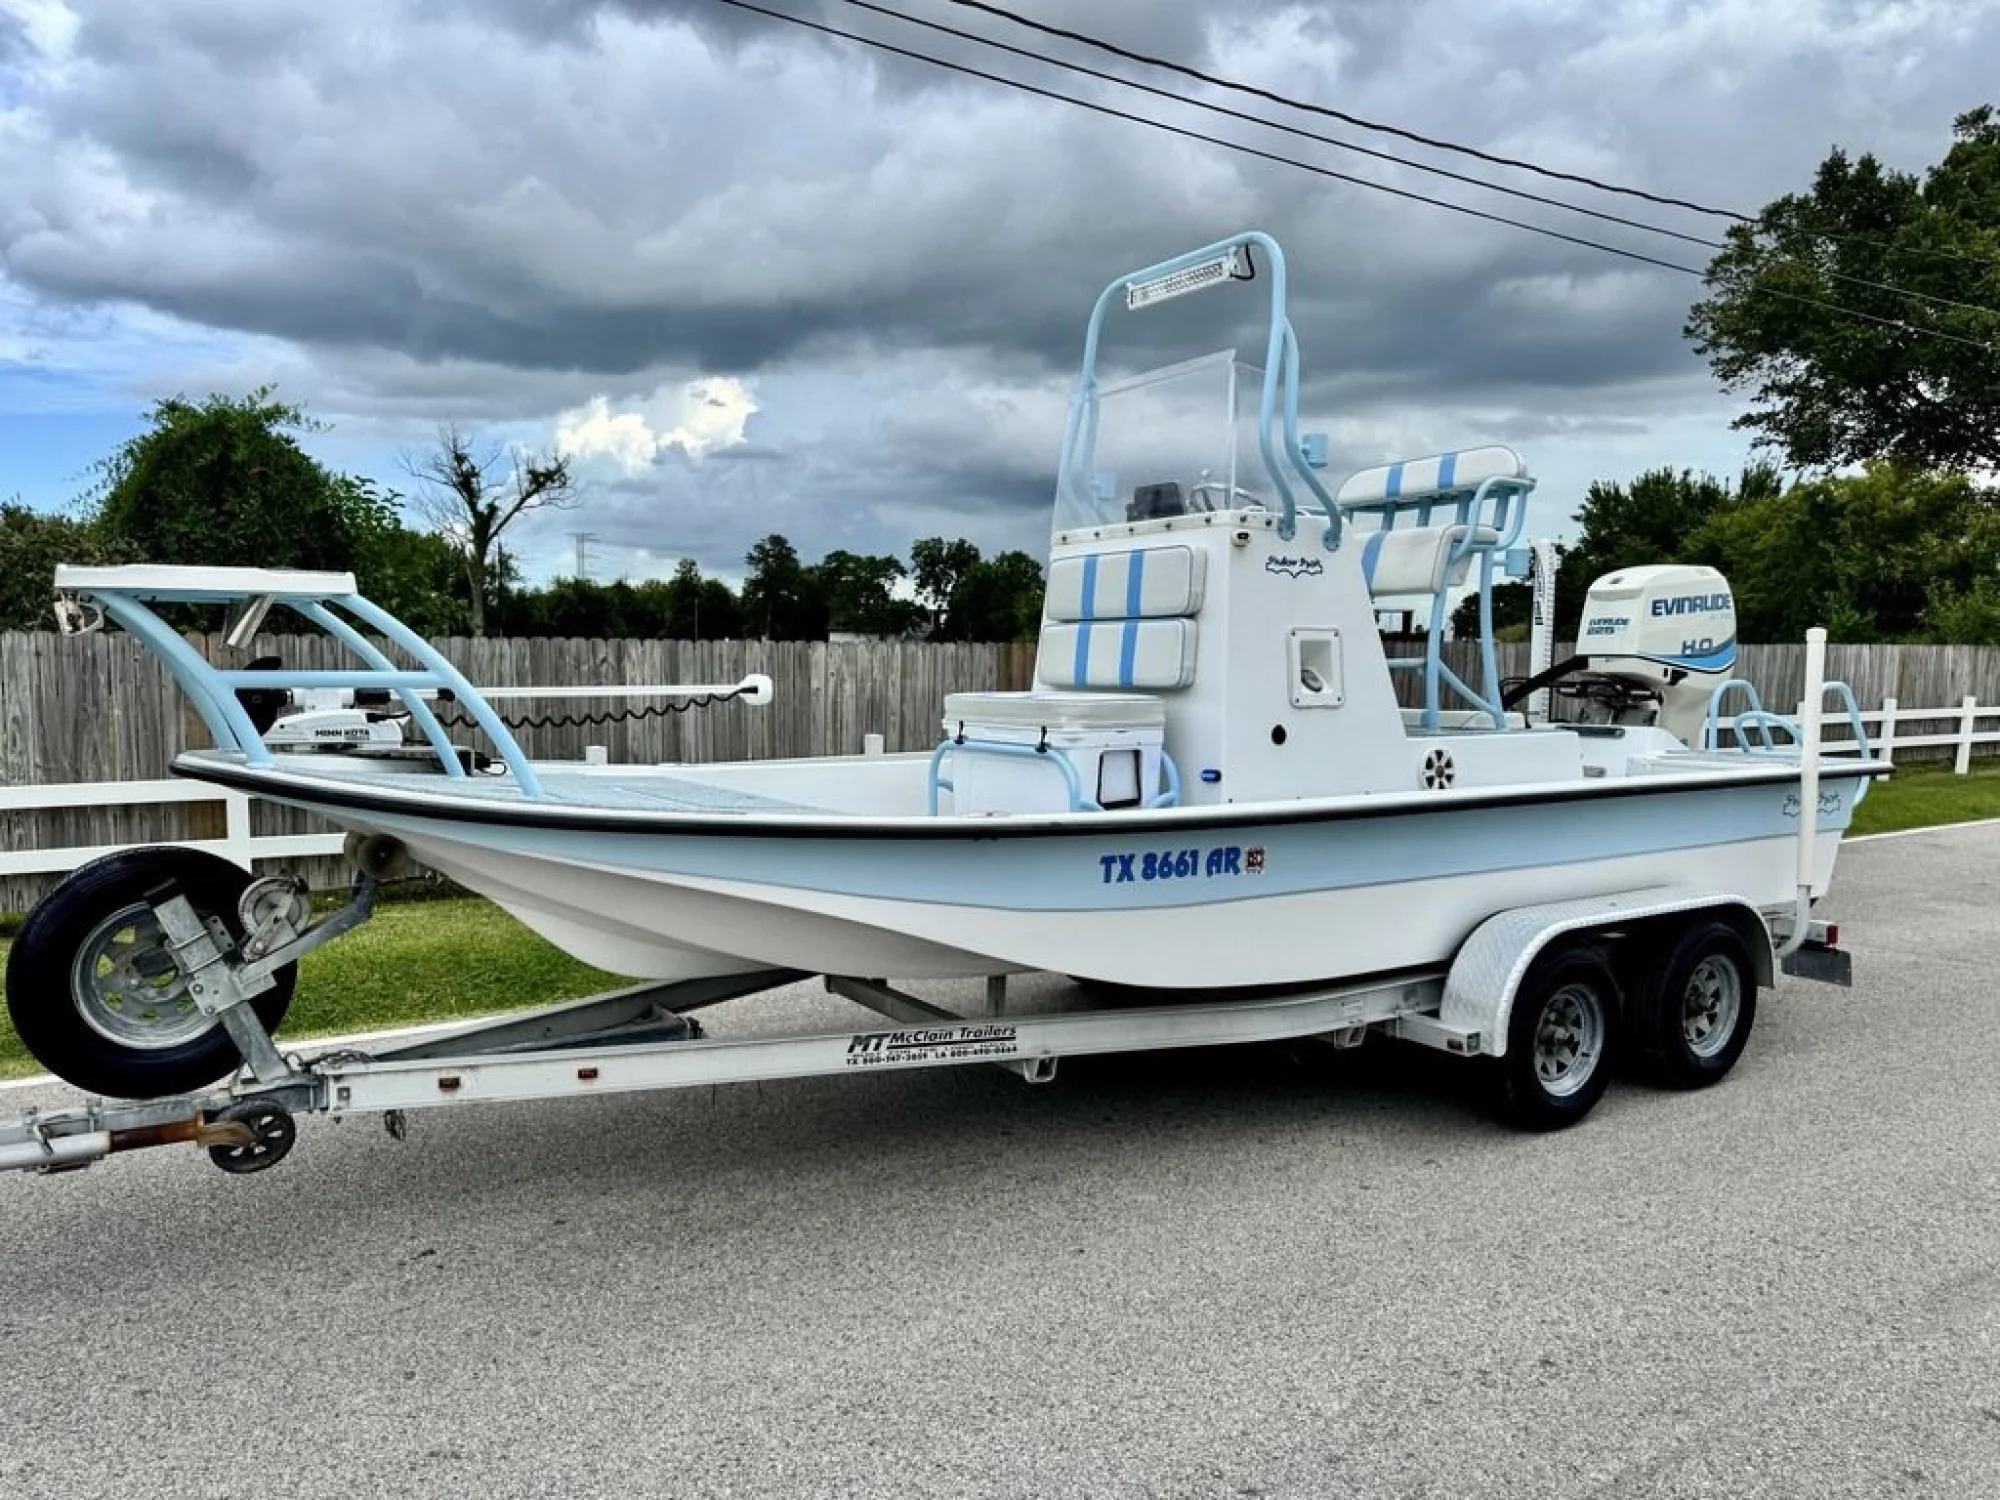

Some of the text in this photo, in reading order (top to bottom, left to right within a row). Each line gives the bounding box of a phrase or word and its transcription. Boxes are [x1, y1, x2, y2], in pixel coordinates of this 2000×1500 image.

[1651, 593, 1732, 616] EVINRUDE
[315, 729, 343, 737] MINN
[1099, 853, 1136, 884] TX
[1141, 848, 1200, 881] 8661
[1205, 845, 1242, 878] AR
[847, 1032, 892, 1054] MT
[890, 1024, 1018, 1044] McClain Trailers
